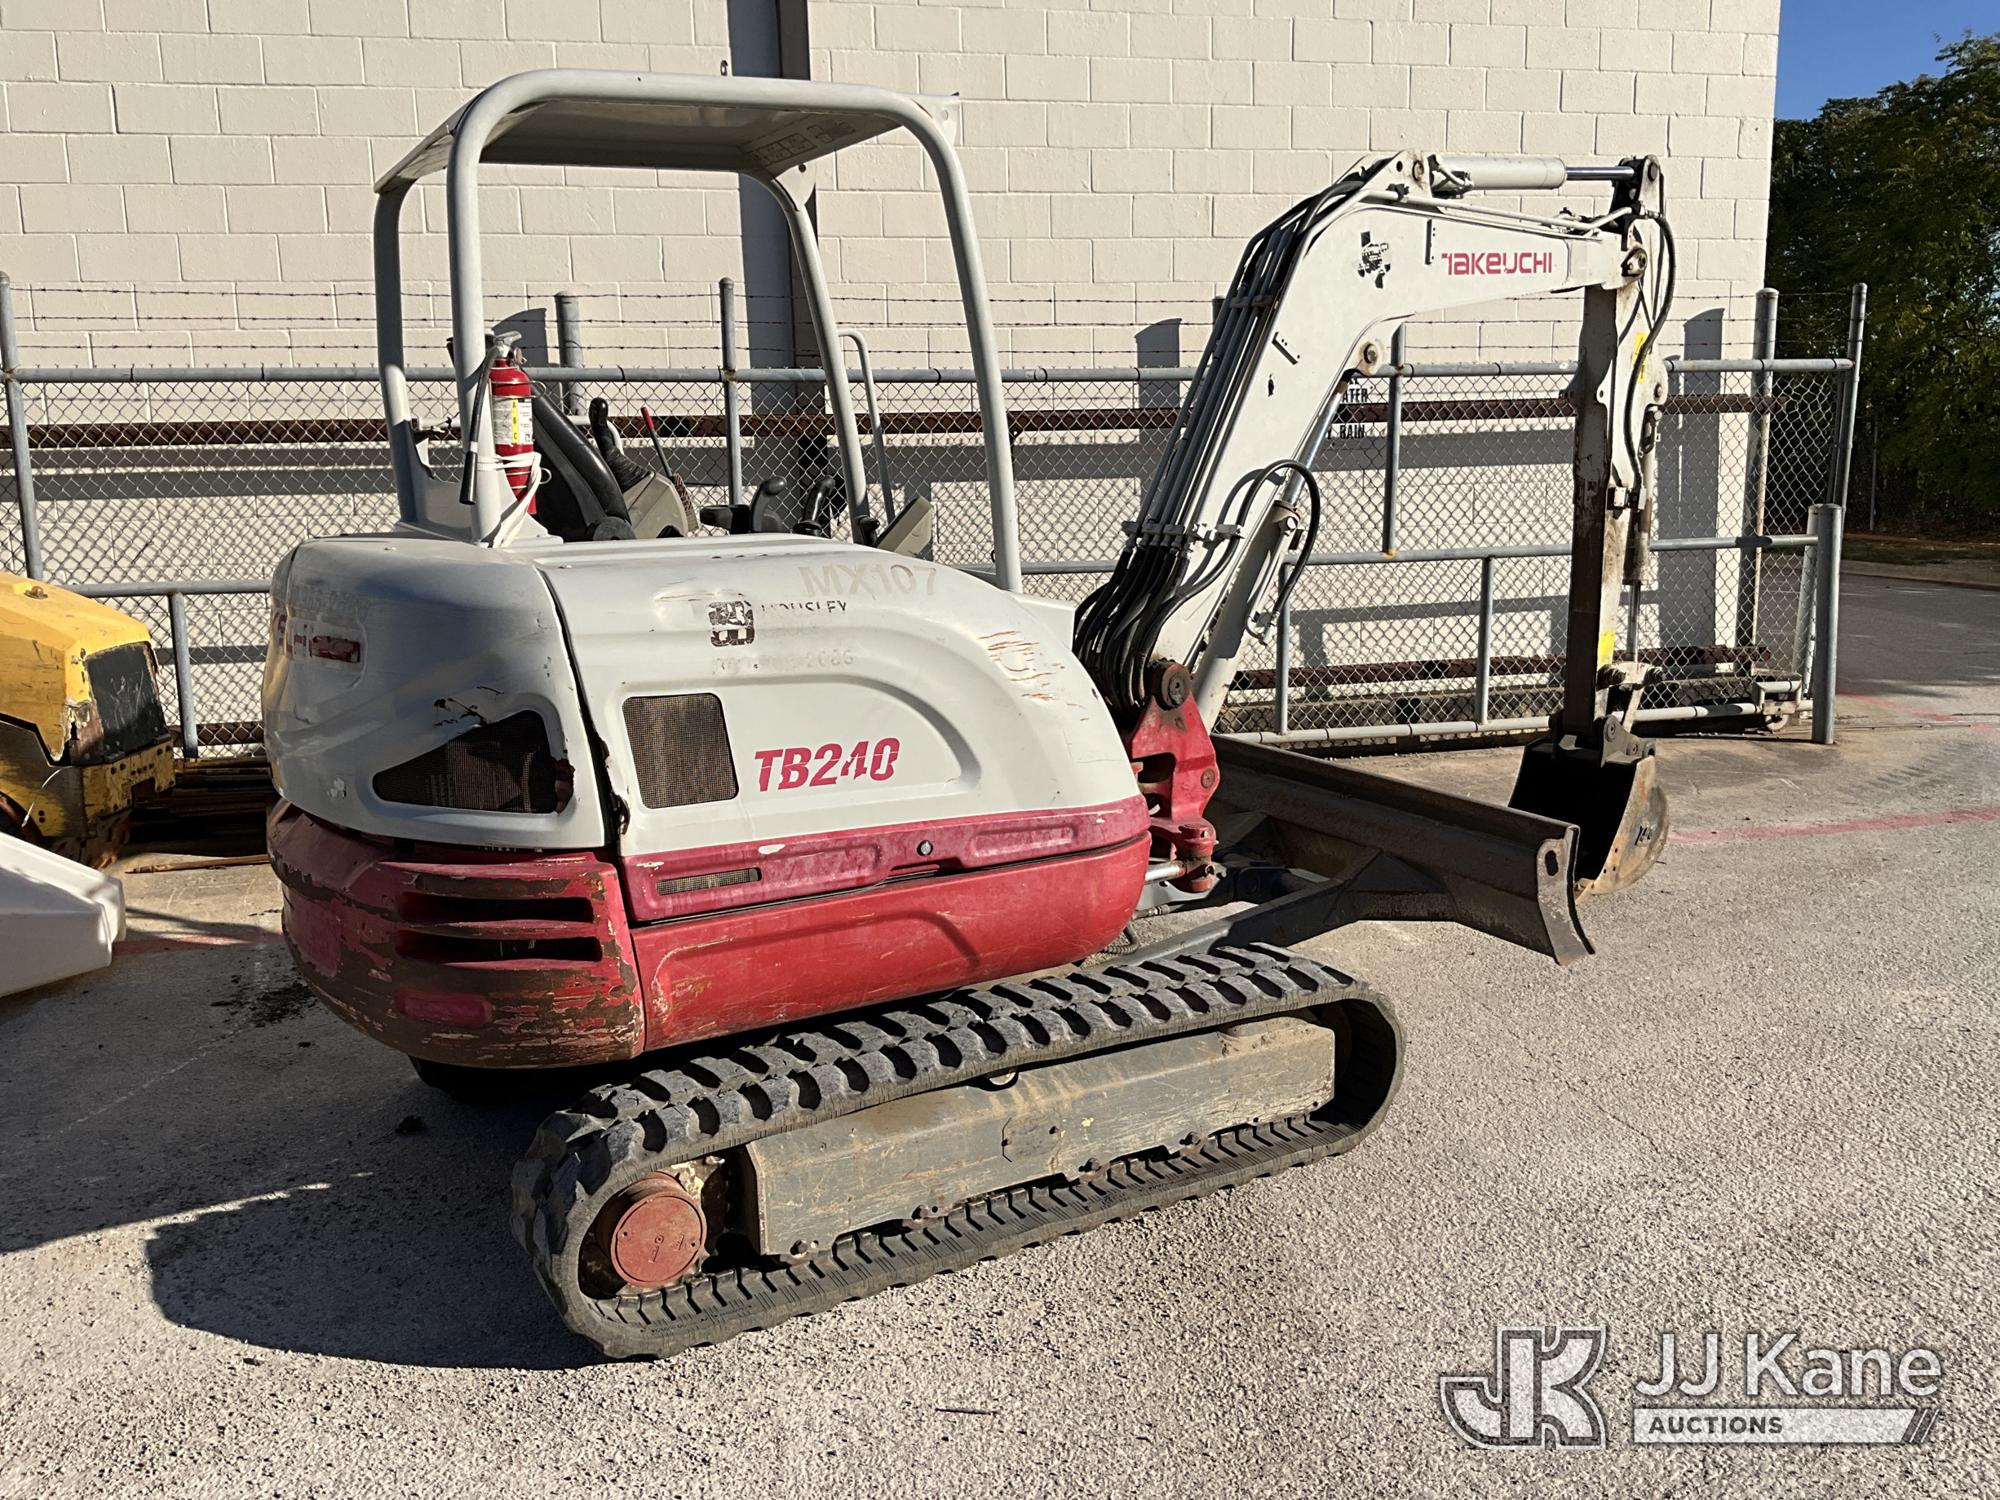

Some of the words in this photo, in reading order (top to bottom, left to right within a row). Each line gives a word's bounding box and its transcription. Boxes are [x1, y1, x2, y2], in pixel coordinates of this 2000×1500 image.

[1342, 388, 1369, 403] ATER
[1340, 424, 1365, 440] RAIN
[799, 565, 937, 598] MX107
[754, 737, 901, 792] TB240
